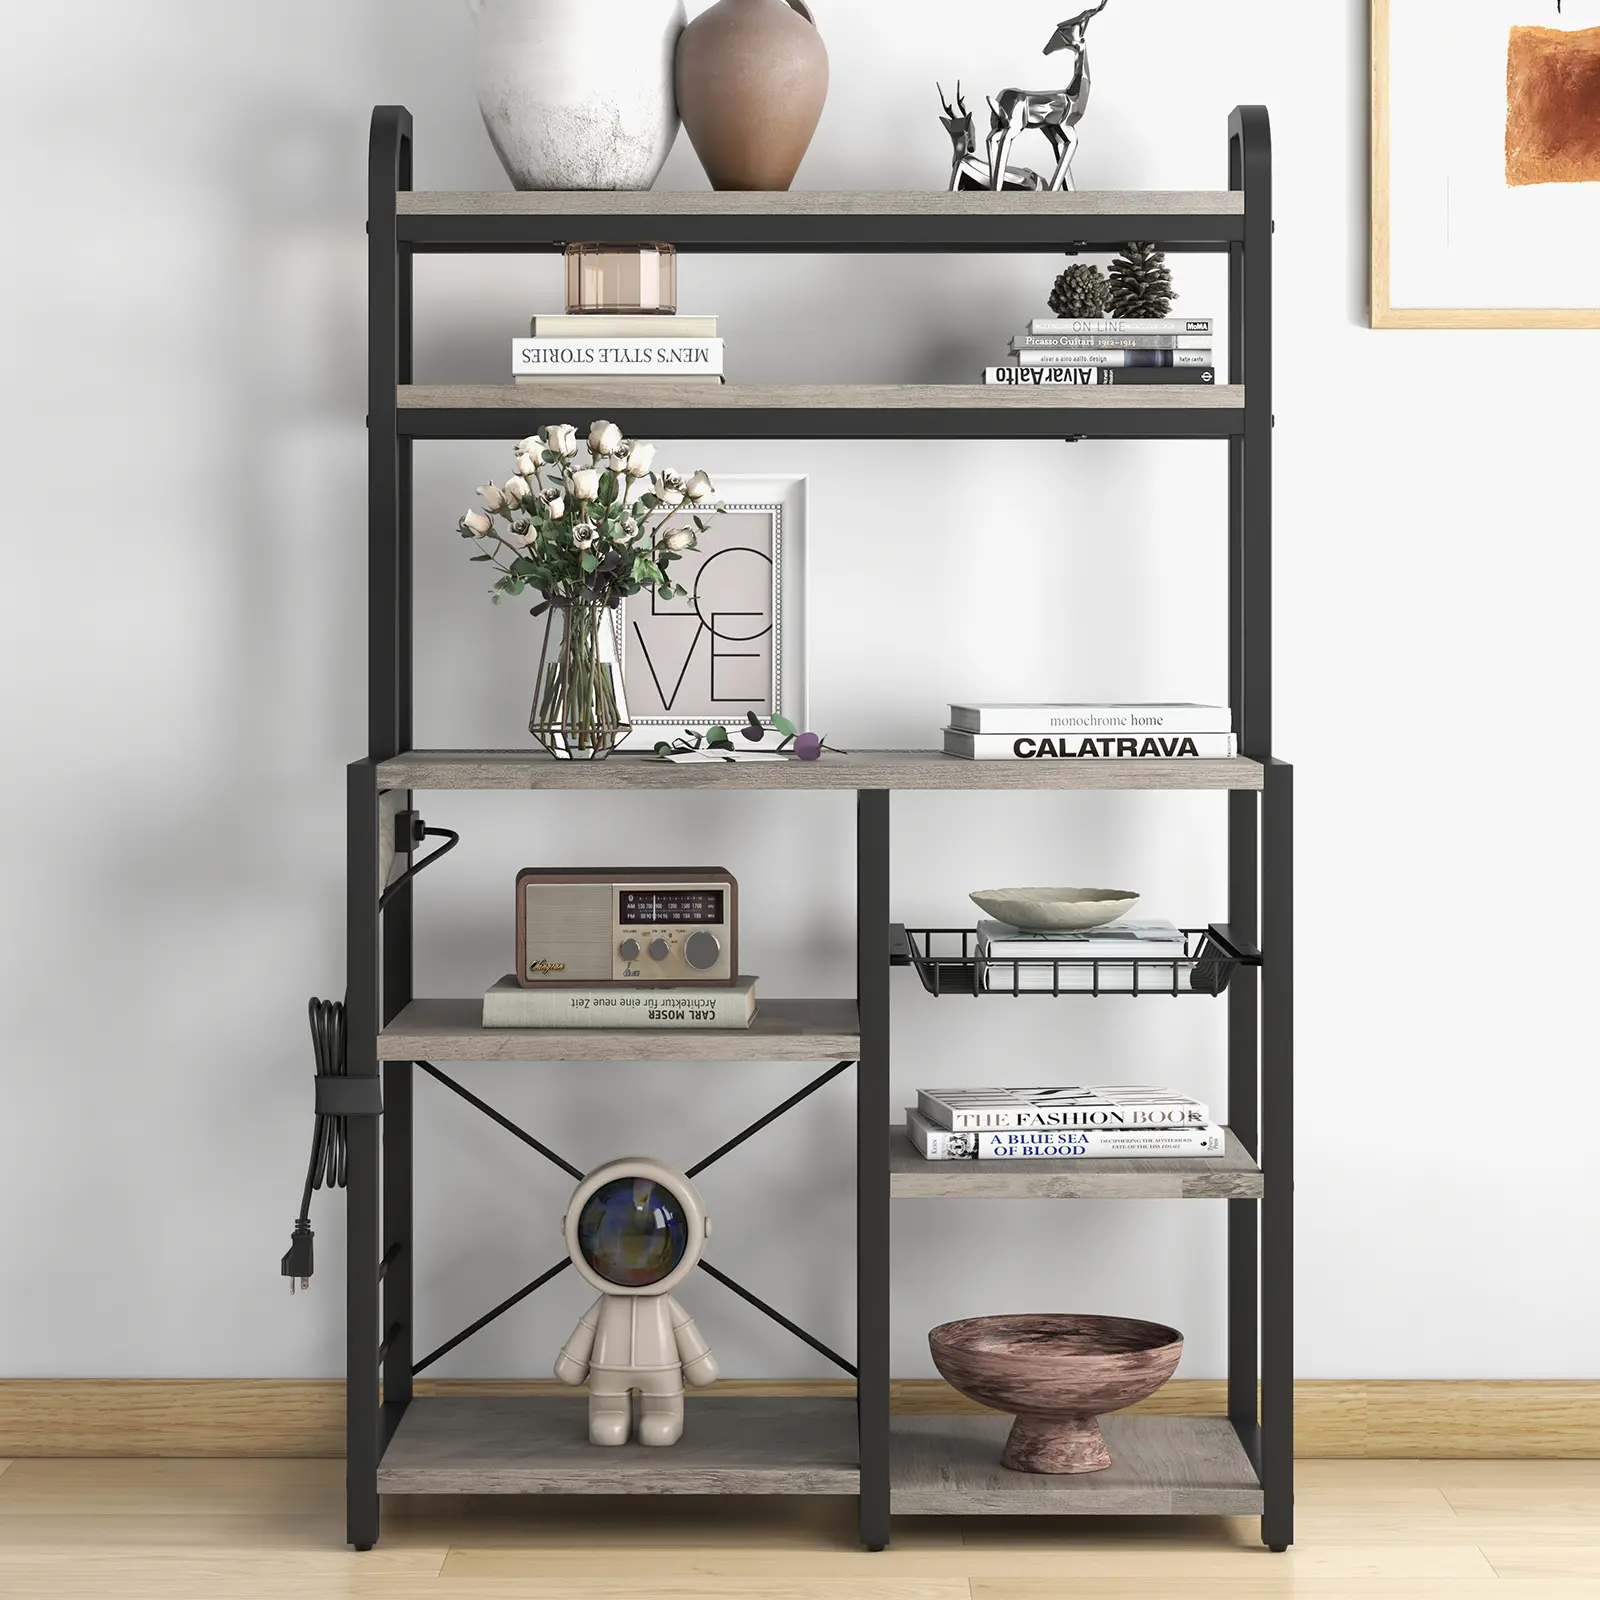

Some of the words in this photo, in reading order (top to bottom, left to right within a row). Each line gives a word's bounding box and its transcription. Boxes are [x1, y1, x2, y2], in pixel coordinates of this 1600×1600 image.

[1072, 321, 1091, 332] ON
[1097, 321, 1126, 332] LINE
[1187, 322, 1208, 331] MoMA
[1025, 336, 1059, 346] Picasso
[1059, 336, 1095, 346] Guitars
[522, 348, 594, 363] STORIES
[599, 348, 652, 363] STYLE
[657, 348, 709, 363] MEN'S
[1050, 714, 1127, 726] monochrome
[1130, 714, 1164, 726] home
[1013, 737, 1199, 758] CALATRAVA
[571, 998, 591, 1009] Zeit
[593, 998, 617, 1007] neue
[619, 999, 641, 1008] eine
[643, 998, 658, 1009] für
[661, 998, 717, 1009] Architektur
[648, 1010, 685, 1020] MOSER
[688, 1010, 716, 1020] CARL
[957, 1112, 1010, 1128] THE
[1016, 1110, 1126, 1127] FASHION
[1132, 1109, 1203, 1125] BOOK
[990, 1133, 1003, 1145] A
[1008, 1133, 1055, 1145] BLUE
[1057, 1133, 1090, 1144] SEA
[993, 1145, 1019, 1156] OF
[1022, 1145, 1086, 1156] BLOOD
